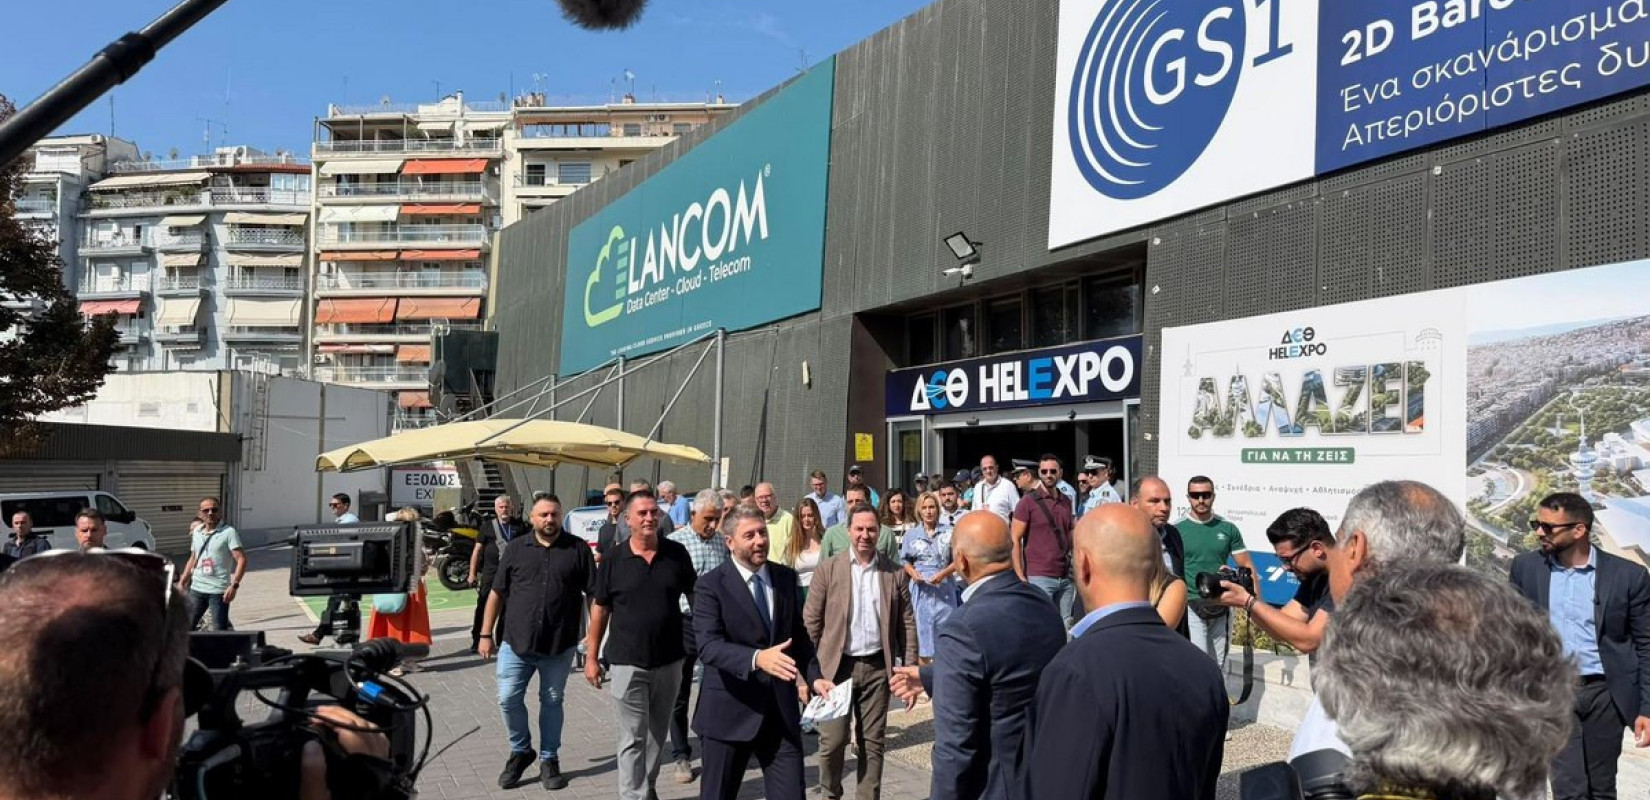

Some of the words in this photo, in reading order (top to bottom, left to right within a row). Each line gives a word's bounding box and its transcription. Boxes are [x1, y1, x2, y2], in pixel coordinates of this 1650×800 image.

[1144, 0, 1293, 105] GS1
[1340, 18, 1394, 66] 2D
[1411, 0, 1522, 41] Bar
[1340, 77, 1401, 112] Ένα
[1412, 0, 1648, 90] σκανάρισμα
[1341, 63, 1581, 151] Απεριόριστες
[1597, 41, 1650, 77] δυ
[627, 169, 769, 295] LANCOM
[626, 298, 643, 314] Data
[644, 286, 670, 307] Center
[676, 269, 702, 295] Cloud
[709, 256, 751, 282] Telecom
[979, 345, 1134, 403] HELEXPO
[1268, 343, 1327, 360] HELEXPO
[405, 473, 455, 486] ΕΞΟΔΟΣ
[1247, 450, 1267, 461] ΓΙΑ
[1272, 450, 1290, 461] ΝΑ
[1294, 450, 1312, 461] ΤΗ
[1316, 450, 1348, 461] ΖΕΙΣ
[416, 488, 435, 500] EXI
